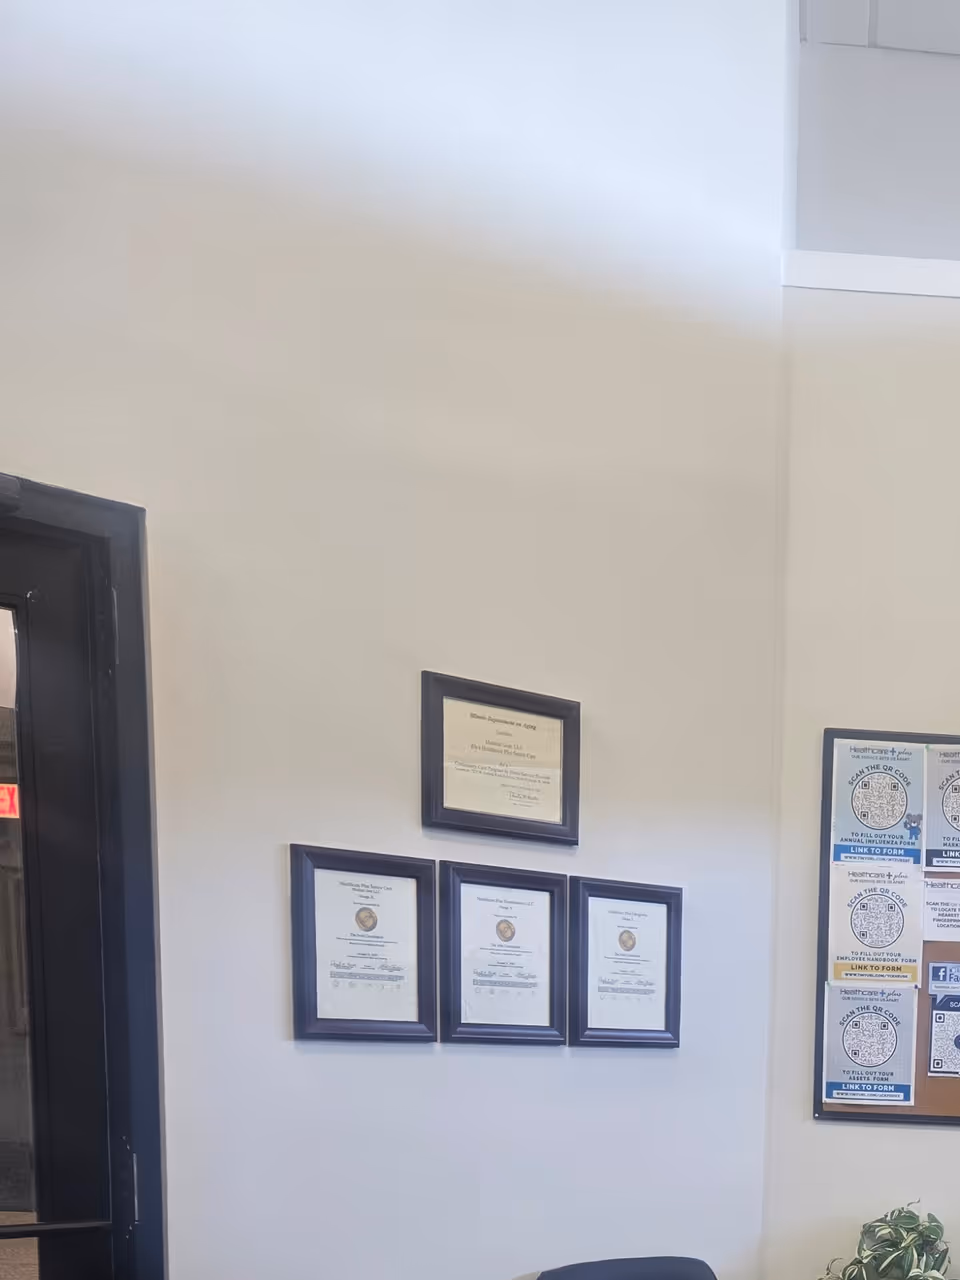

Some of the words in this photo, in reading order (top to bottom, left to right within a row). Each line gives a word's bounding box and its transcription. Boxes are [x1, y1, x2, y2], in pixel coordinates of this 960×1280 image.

[849, 746, 889, 754] Healthcare
[848, 769, 865, 786] SCAN
[882, 764, 893, 772] QR
[894, 769, 911, 787] CODE
[939, 773, 955, 790] SCAN
[847, 892, 863, 908] SCAN
[864, 887, 878, 895] THE
[891, 891, 908, 908] CODE
[886, 990, 902, 998] plus
[839, 1010, 856, 1026] SCAN
[872, 1005, 883, 1013] QR
[884, 1009, 901, 1026] CODE
